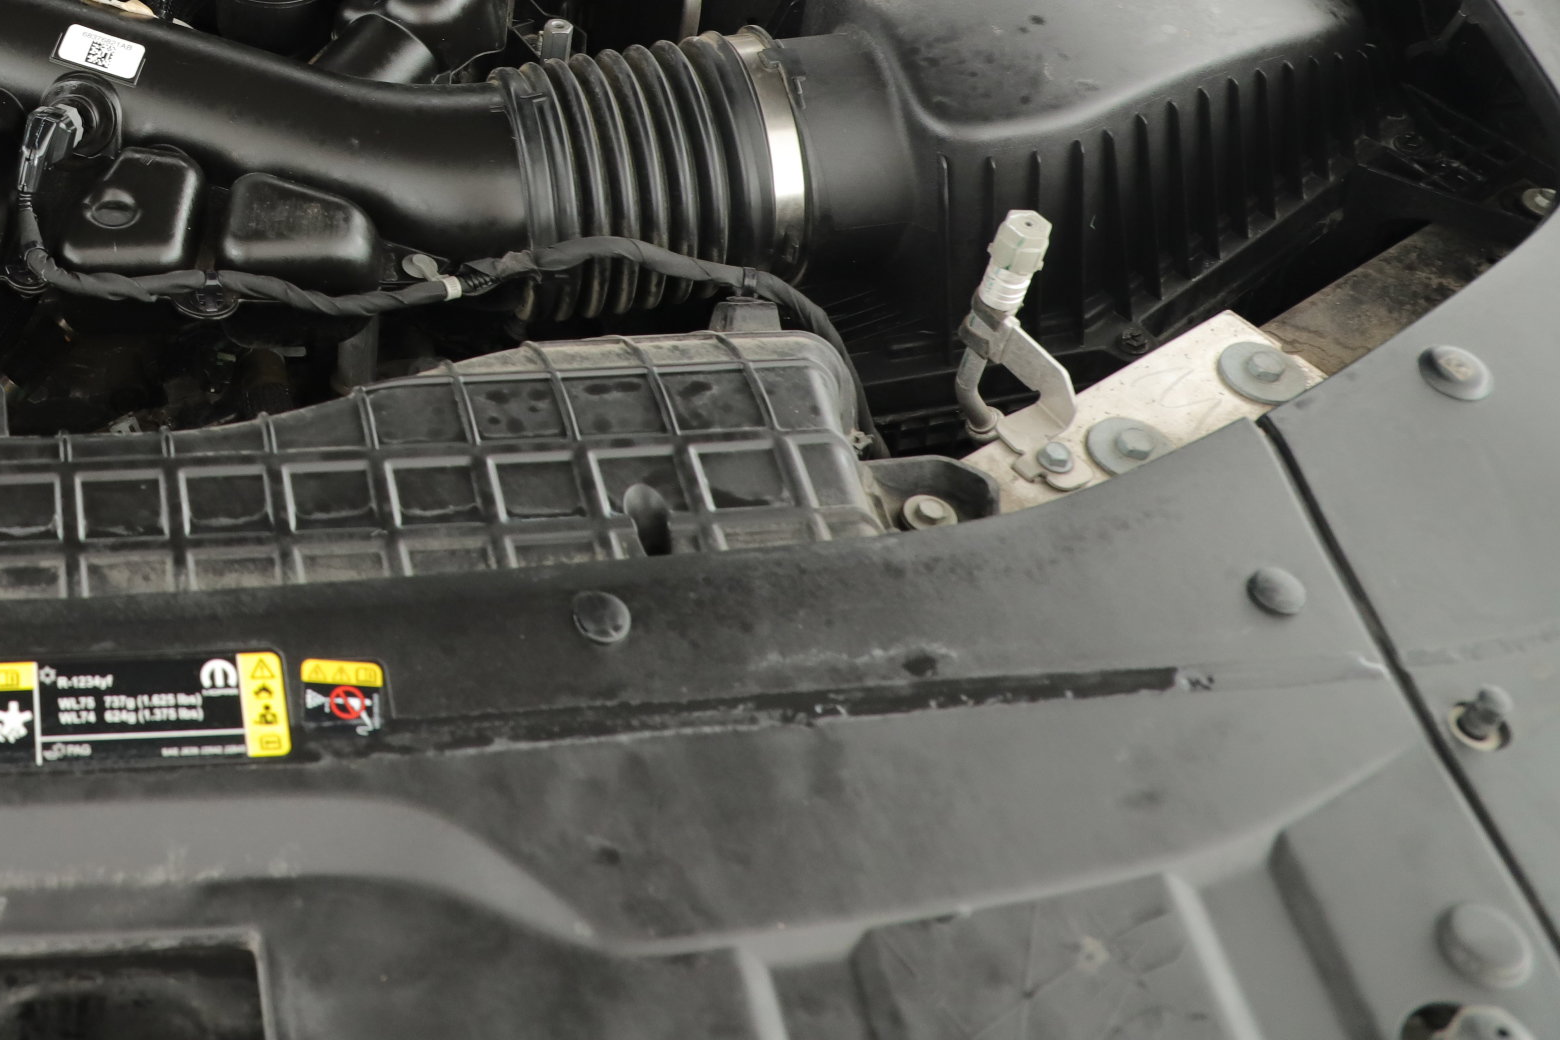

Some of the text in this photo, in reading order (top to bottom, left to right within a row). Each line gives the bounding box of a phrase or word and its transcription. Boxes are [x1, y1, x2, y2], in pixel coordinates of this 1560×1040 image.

[57, 674, 114, 690] R-1234yf
[58, 696, 96, 710] WL75
[104, 695, 136, 710] 737g
